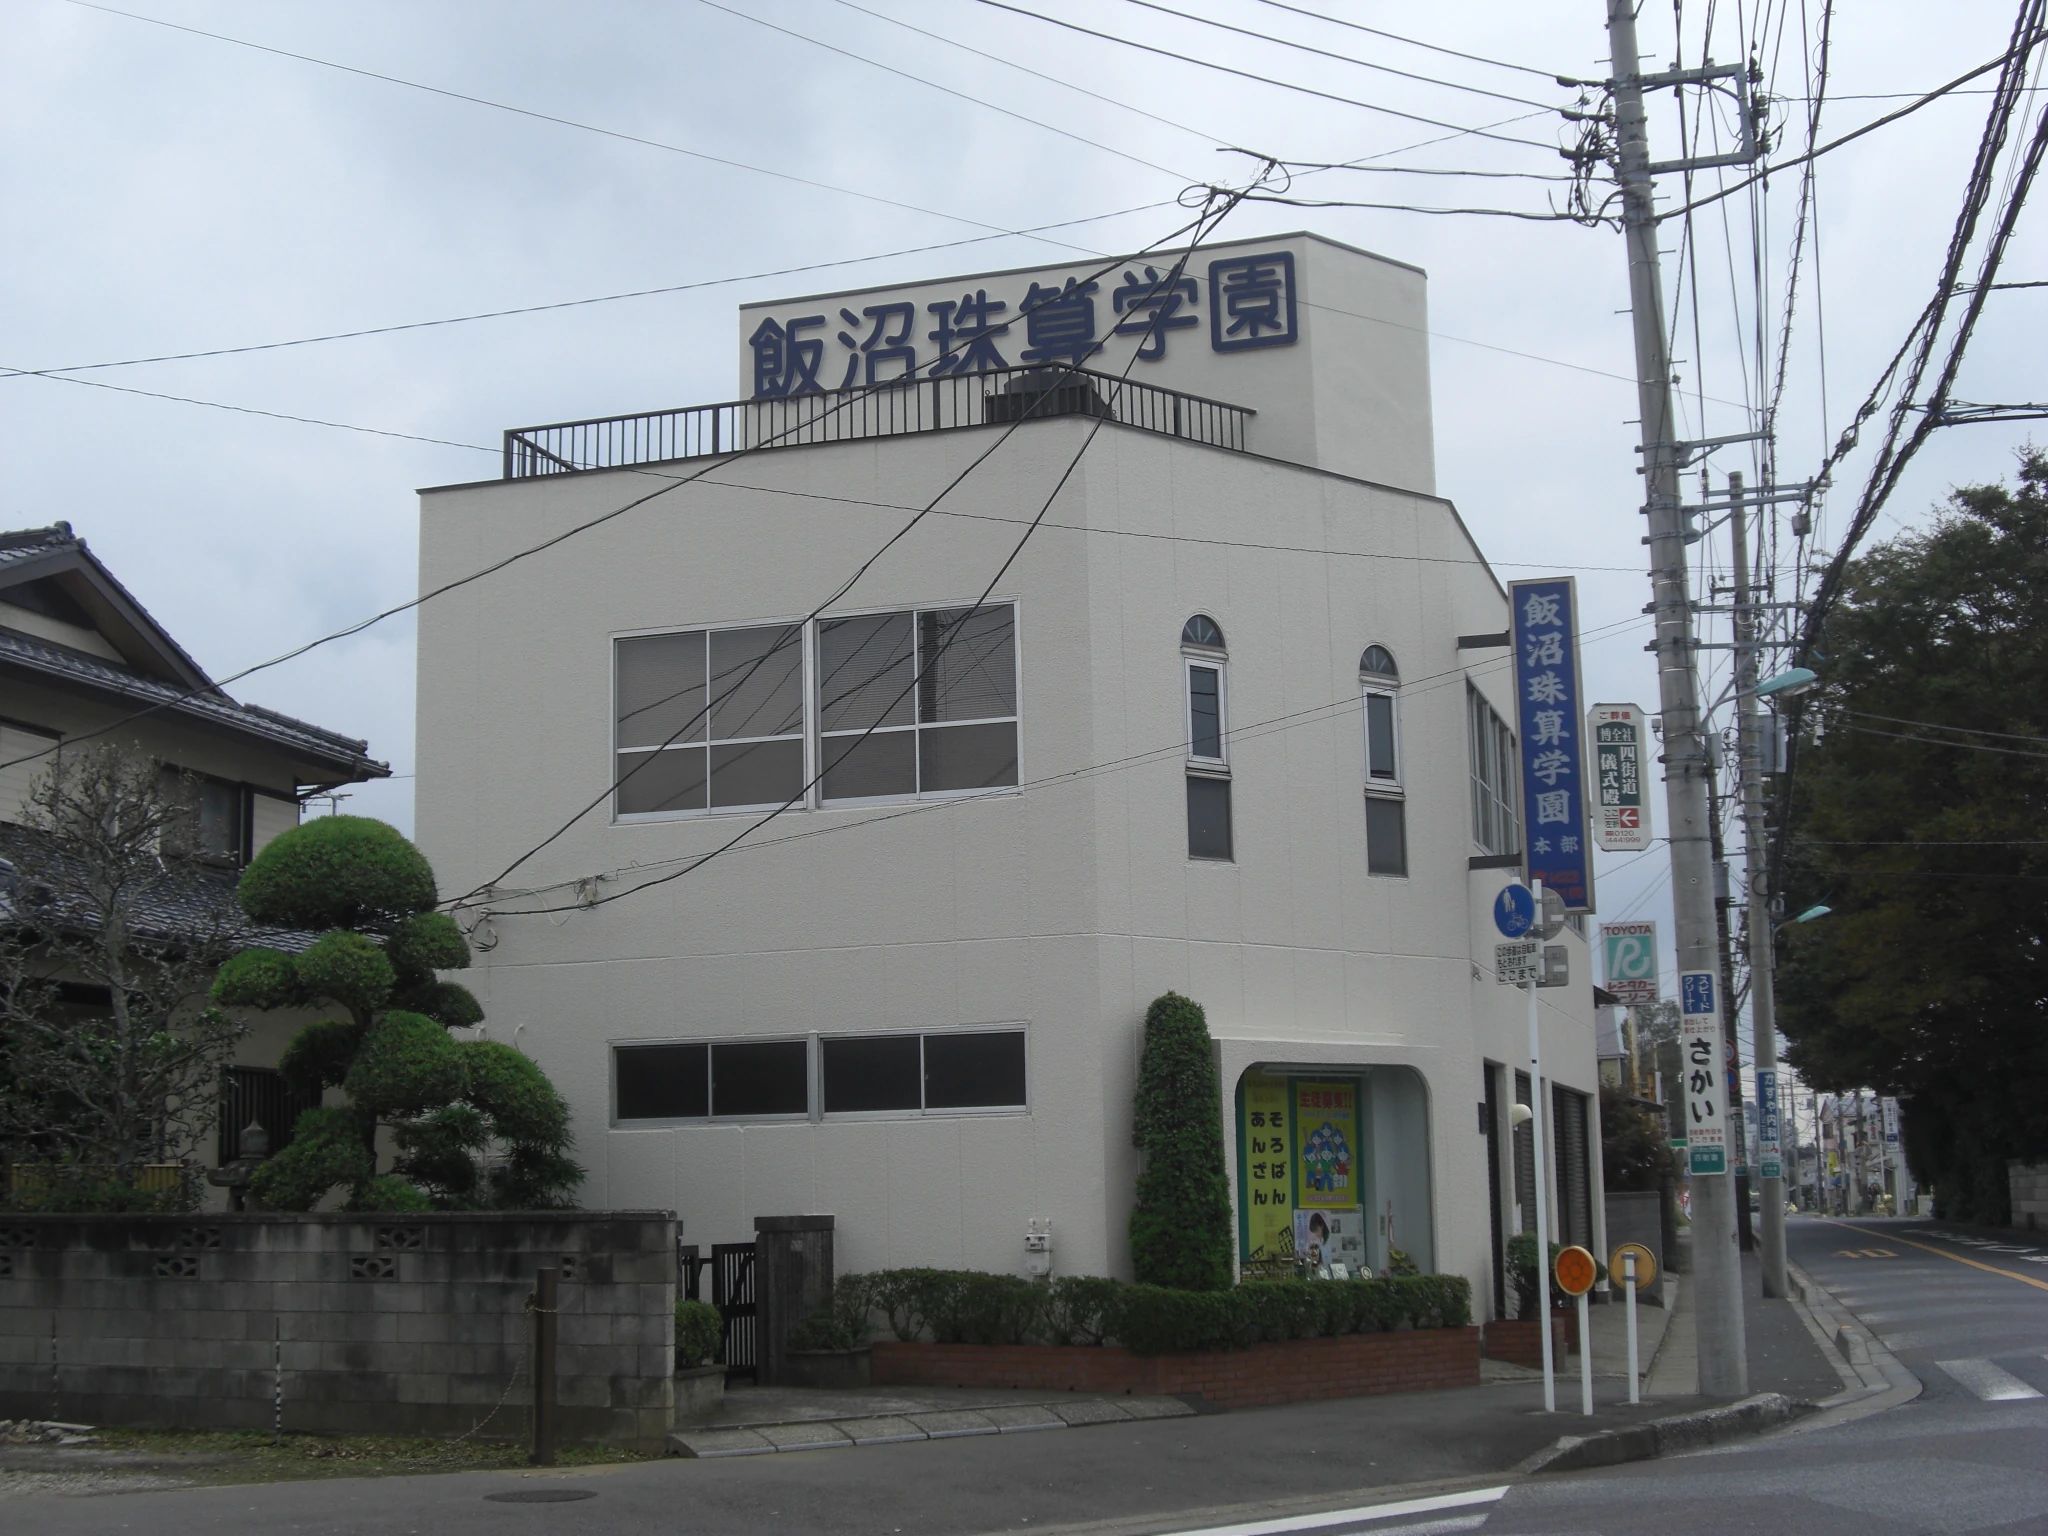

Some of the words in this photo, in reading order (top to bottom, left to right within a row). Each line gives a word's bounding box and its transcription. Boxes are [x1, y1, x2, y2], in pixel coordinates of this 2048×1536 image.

[749, 250, 1299, 402] 飯沼珠算学園
[1523, 593, 1571, 825] 飯沼珠算学園
[1600, 727, 1632, 742] 博全社
[1600, 753, 1620, 804] 儀式殿
[1620, 746, 1638, 795] 四街道
[1604, 925, 1652, 936] TOYOTA
[1499, 968, 1537, 982] ここまで
[1607, 980, 1657, 990] レンタカー
[1699, 976, 1711, 1012] スピード
[1689, 1037, 1715, 1124] さかい
[1250, 1111, 1268, 1206] あんざん
[1269, 1111, 1287, 1206] そろばん
